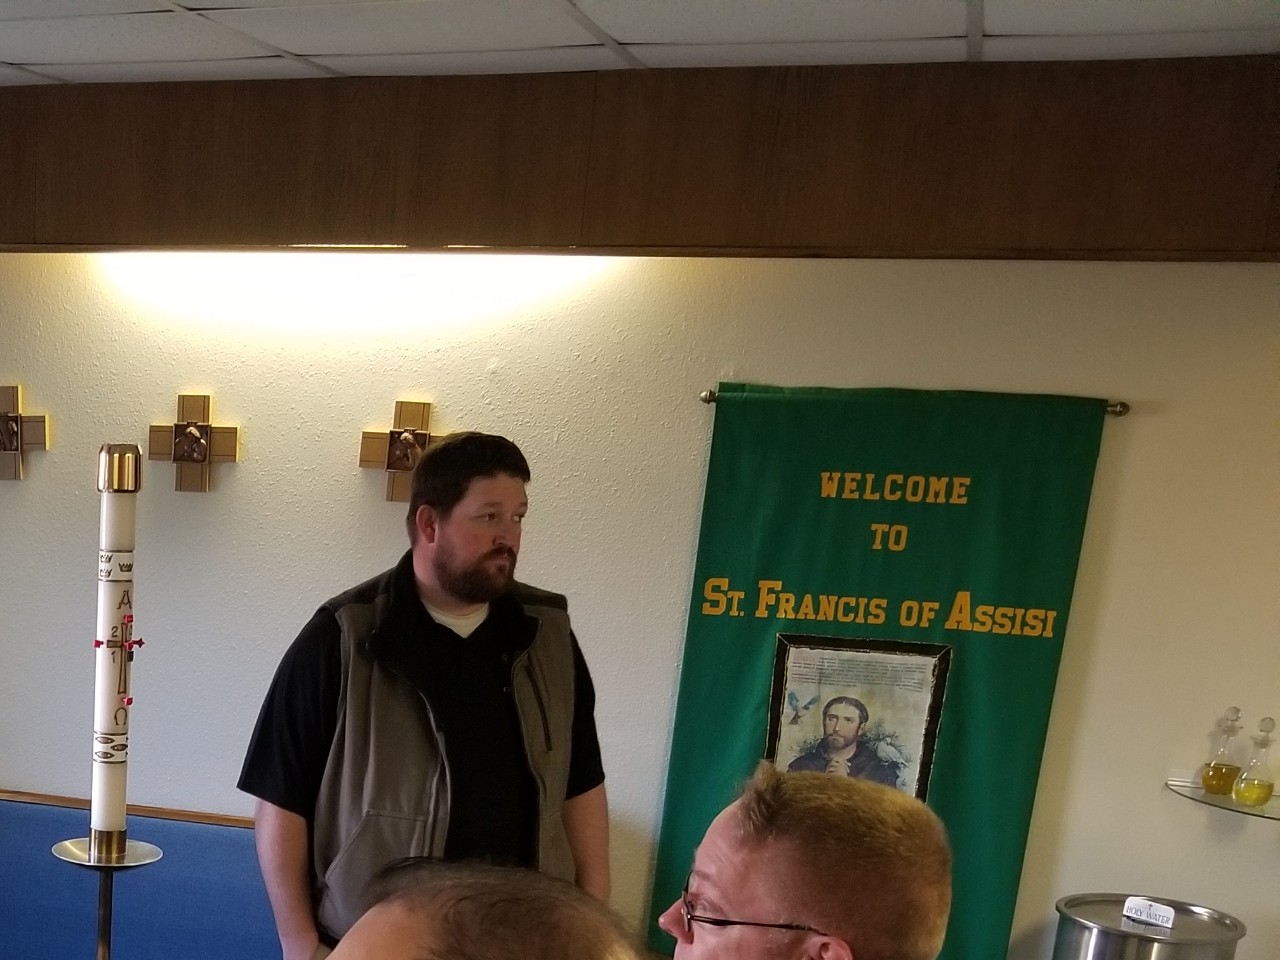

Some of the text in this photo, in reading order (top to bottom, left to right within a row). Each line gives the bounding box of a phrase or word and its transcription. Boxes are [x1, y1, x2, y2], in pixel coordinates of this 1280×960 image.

[820, 472, 970, 504] WELCOME
[871, 523, 908, 551] TO
[755, 580, 888, 624] FRANCIS
[900, 601, 939, 628] OF
[944, 591, 1057, 638] ASSISI
[1126, 906, 1171, 925] HOLY WATER
